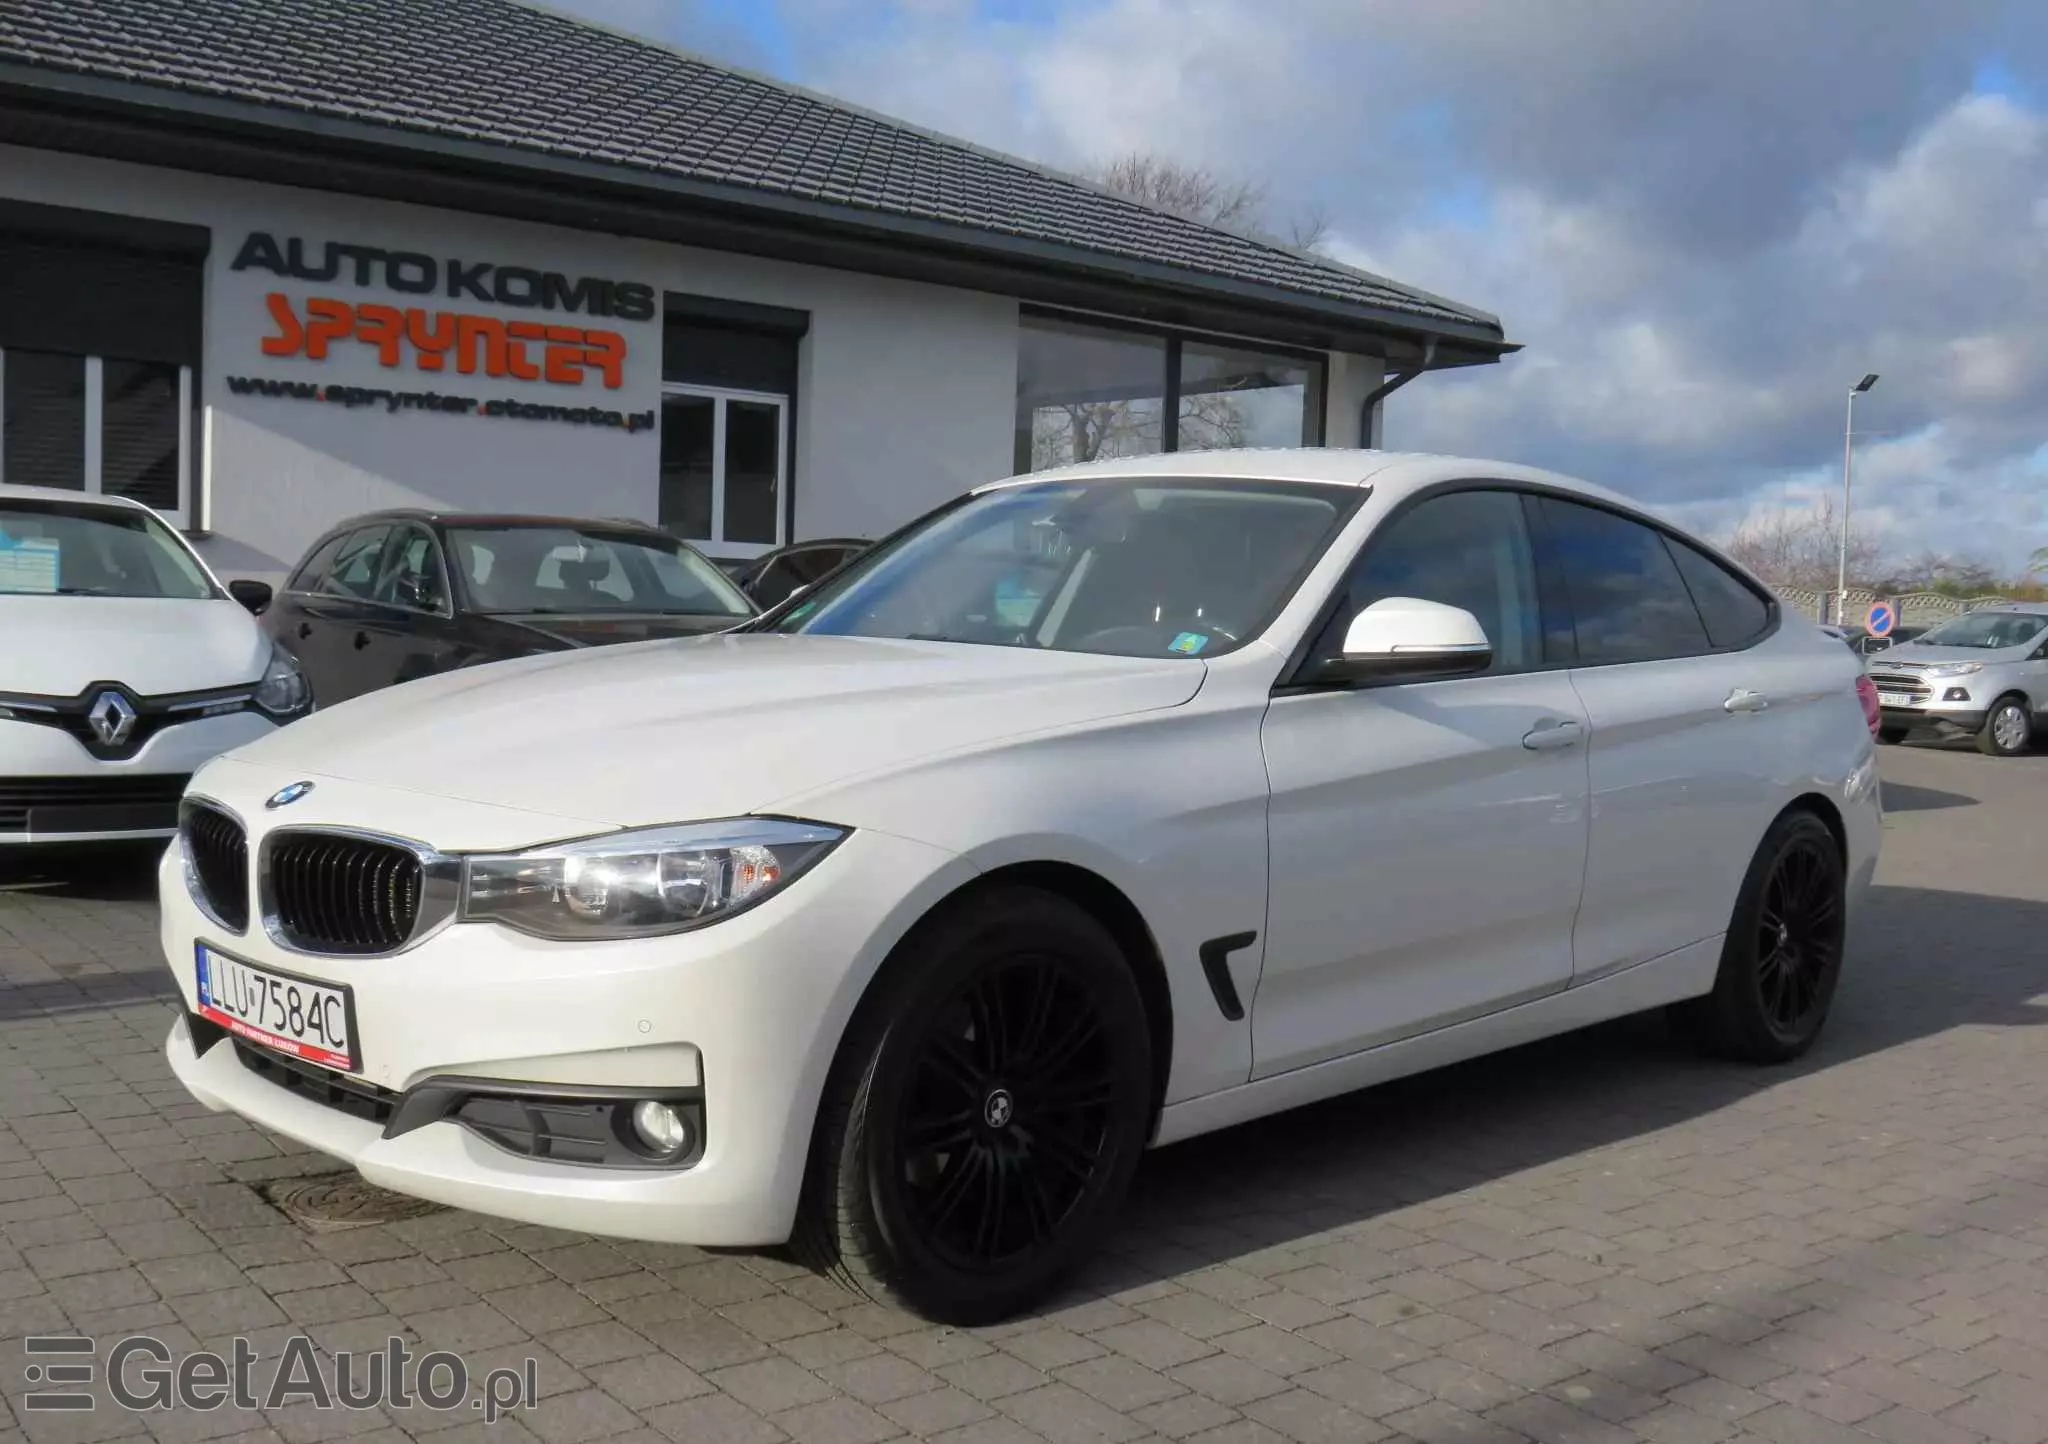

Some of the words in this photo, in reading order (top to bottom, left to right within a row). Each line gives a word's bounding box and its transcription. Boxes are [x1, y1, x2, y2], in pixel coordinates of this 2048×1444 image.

[231, 231, 437, 294] AUTO
[447, 259, 656, 321] KOMIS
[261, 292, 627, 389] SPRYNTER
[226, 375, 655, 433] www.sprynter.otomoto.pl
[254, 974, 344, 1048] 7584C
